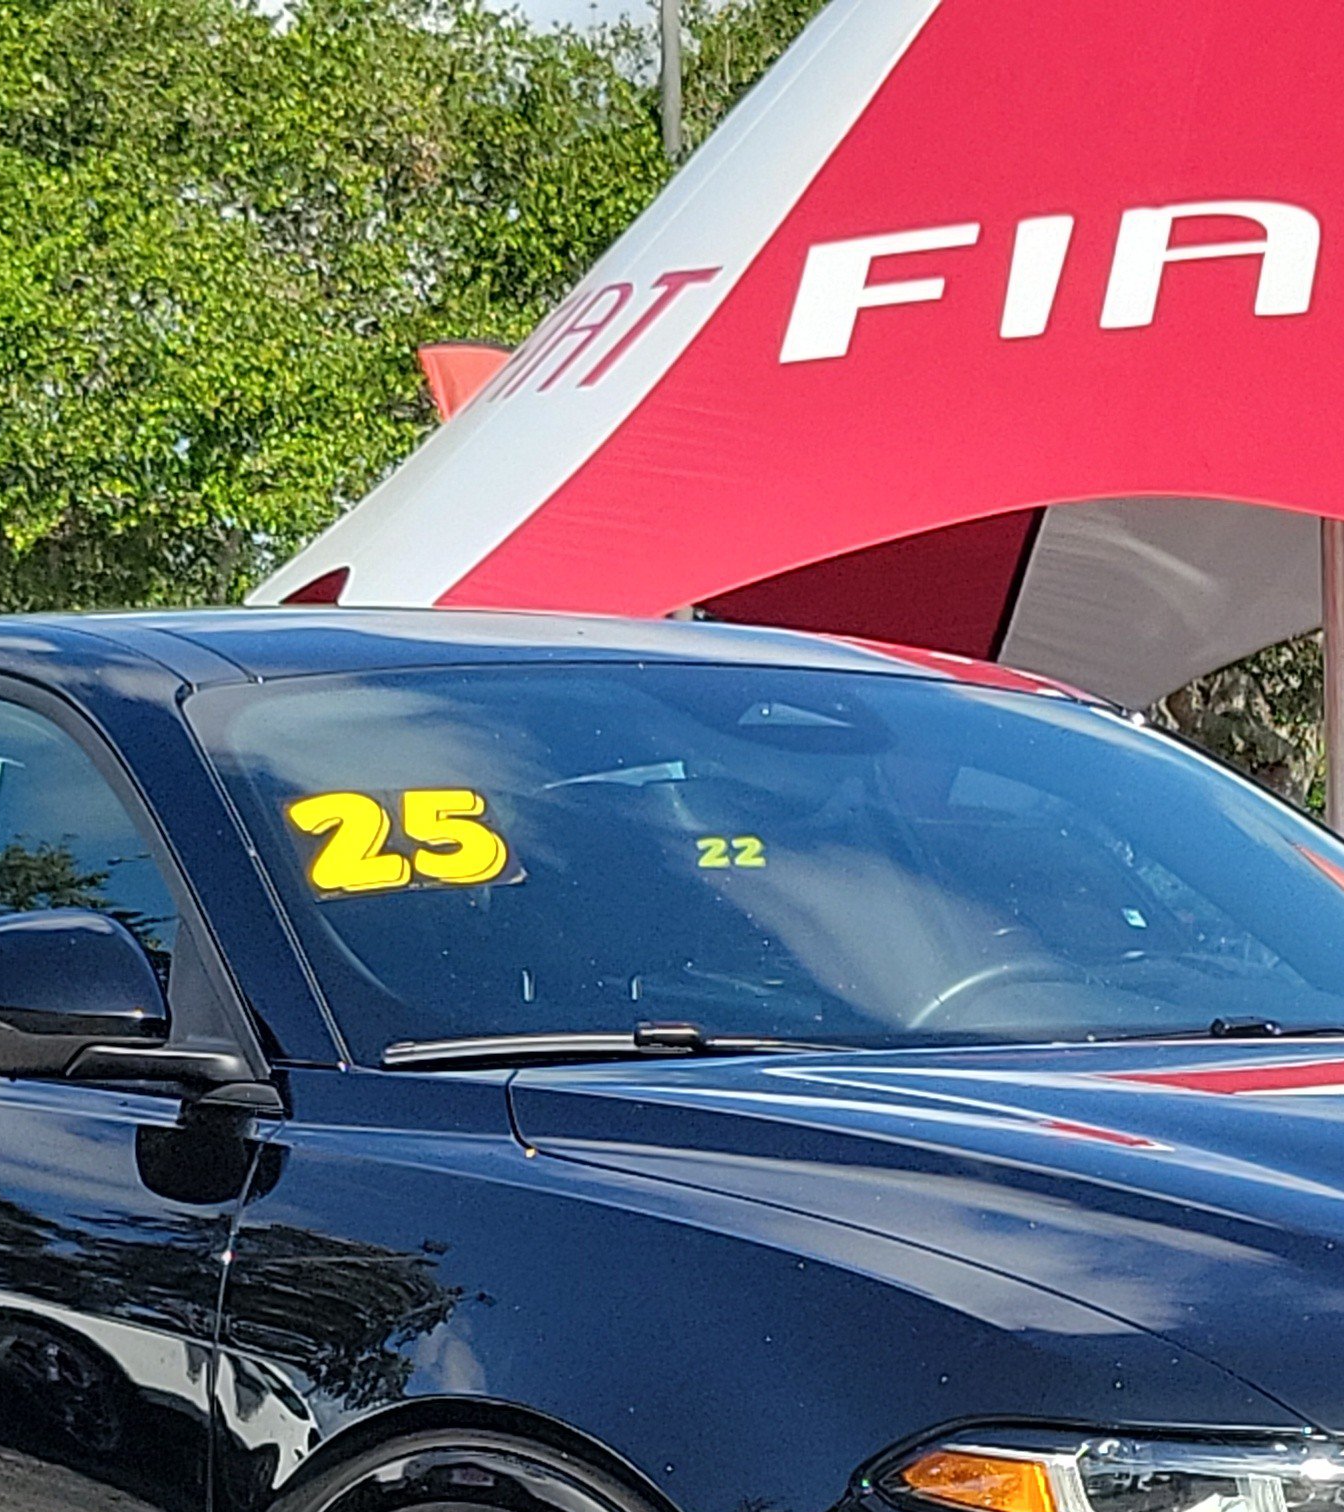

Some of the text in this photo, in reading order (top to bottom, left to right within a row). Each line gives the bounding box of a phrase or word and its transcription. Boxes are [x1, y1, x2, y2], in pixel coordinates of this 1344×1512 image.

[480, 266, 724, 403] IAT
[287, 788, 509, 893] 25
[696, 836, 767, 868] 22
